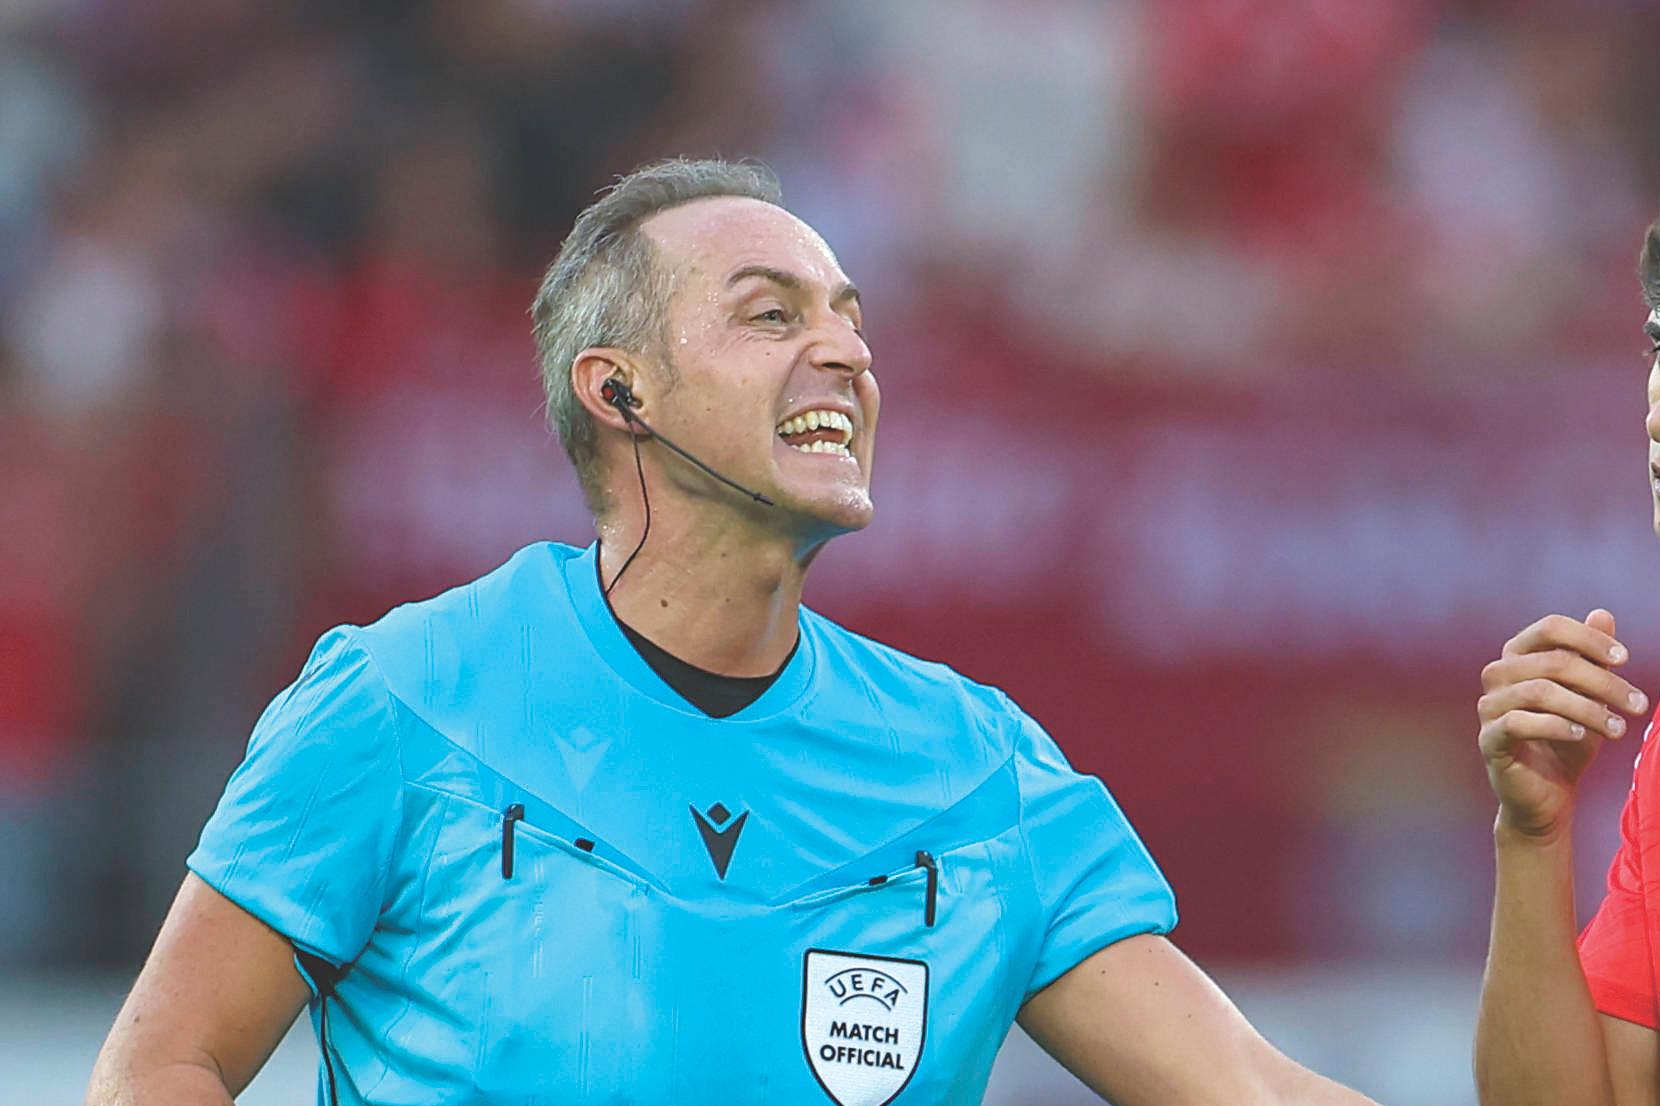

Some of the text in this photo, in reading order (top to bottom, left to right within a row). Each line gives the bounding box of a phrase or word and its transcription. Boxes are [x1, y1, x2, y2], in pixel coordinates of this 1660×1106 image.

[829, 973, 900, 1006] UEFA
[829, 1021, 899, 1044] MATCH
[820, 1045, 904, 1070] OFFICIAL
